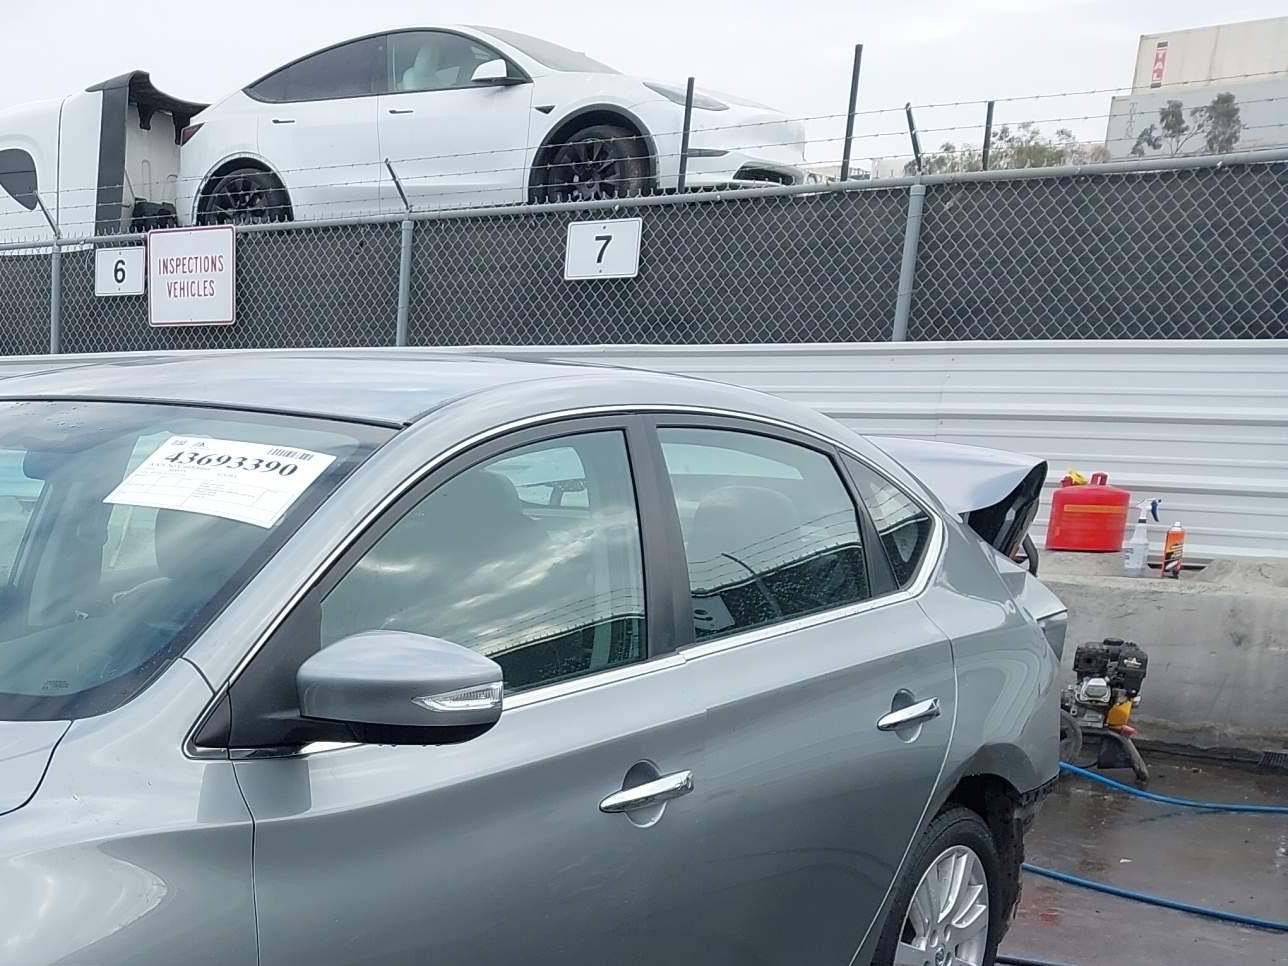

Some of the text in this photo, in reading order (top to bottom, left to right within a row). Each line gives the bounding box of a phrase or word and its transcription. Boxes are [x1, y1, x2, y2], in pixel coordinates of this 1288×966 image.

[1152, 49, 1167, 81] TAL
[595, 235, 612, 263] 7
[113, 259, 126, 283] 6
[158, 255, 224, 275] INSPECTIONS
[167, 280, 215, 298] VEHICLES
[165, 451, 298, 476] 43693390
